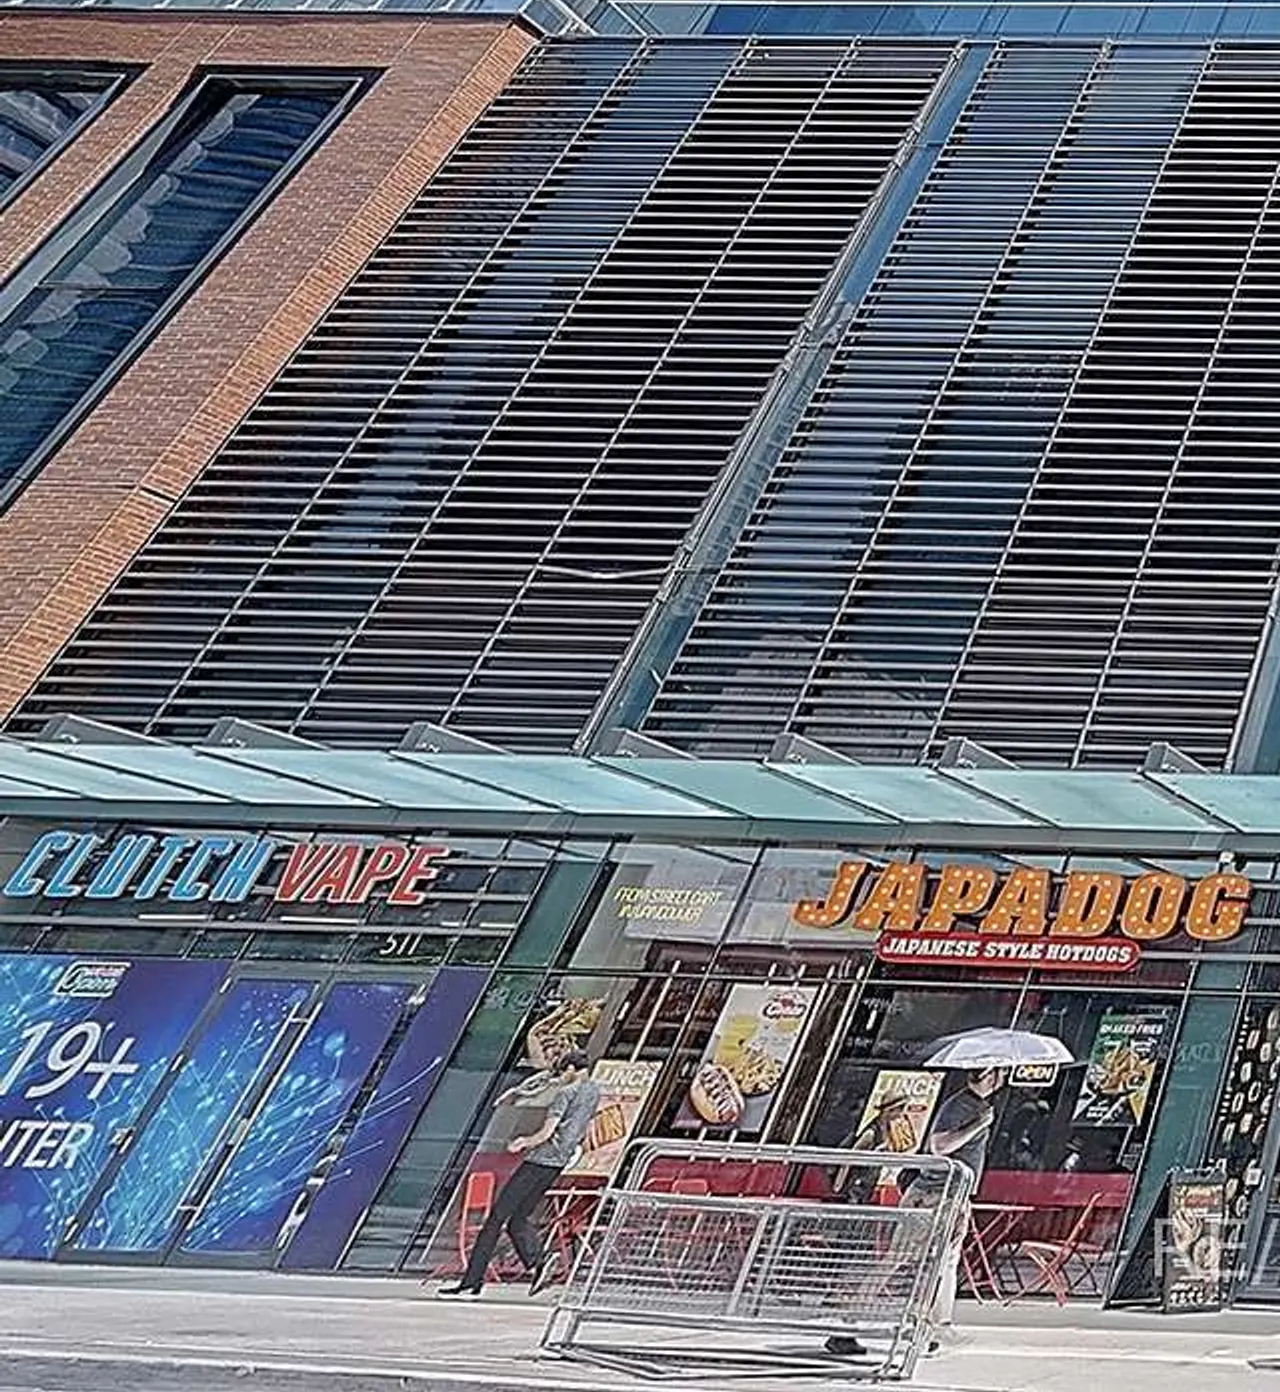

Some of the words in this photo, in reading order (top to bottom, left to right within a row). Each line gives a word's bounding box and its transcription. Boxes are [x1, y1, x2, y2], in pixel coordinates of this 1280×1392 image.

[3, 830, 277, 901] CLUTCH
[275, 841, 450, 905] VAPE
[793, 861, 1252, 942] JAPADOG
[881, 937, 979, 957] JAPANESE
[983, 941, 1043, 960] STYLE
[1044, 943, 1133, 964] HOTDOGS
[0, 1020, 140, 1100] 19+
[1015, 1064, 1053, 1081] OPEN
